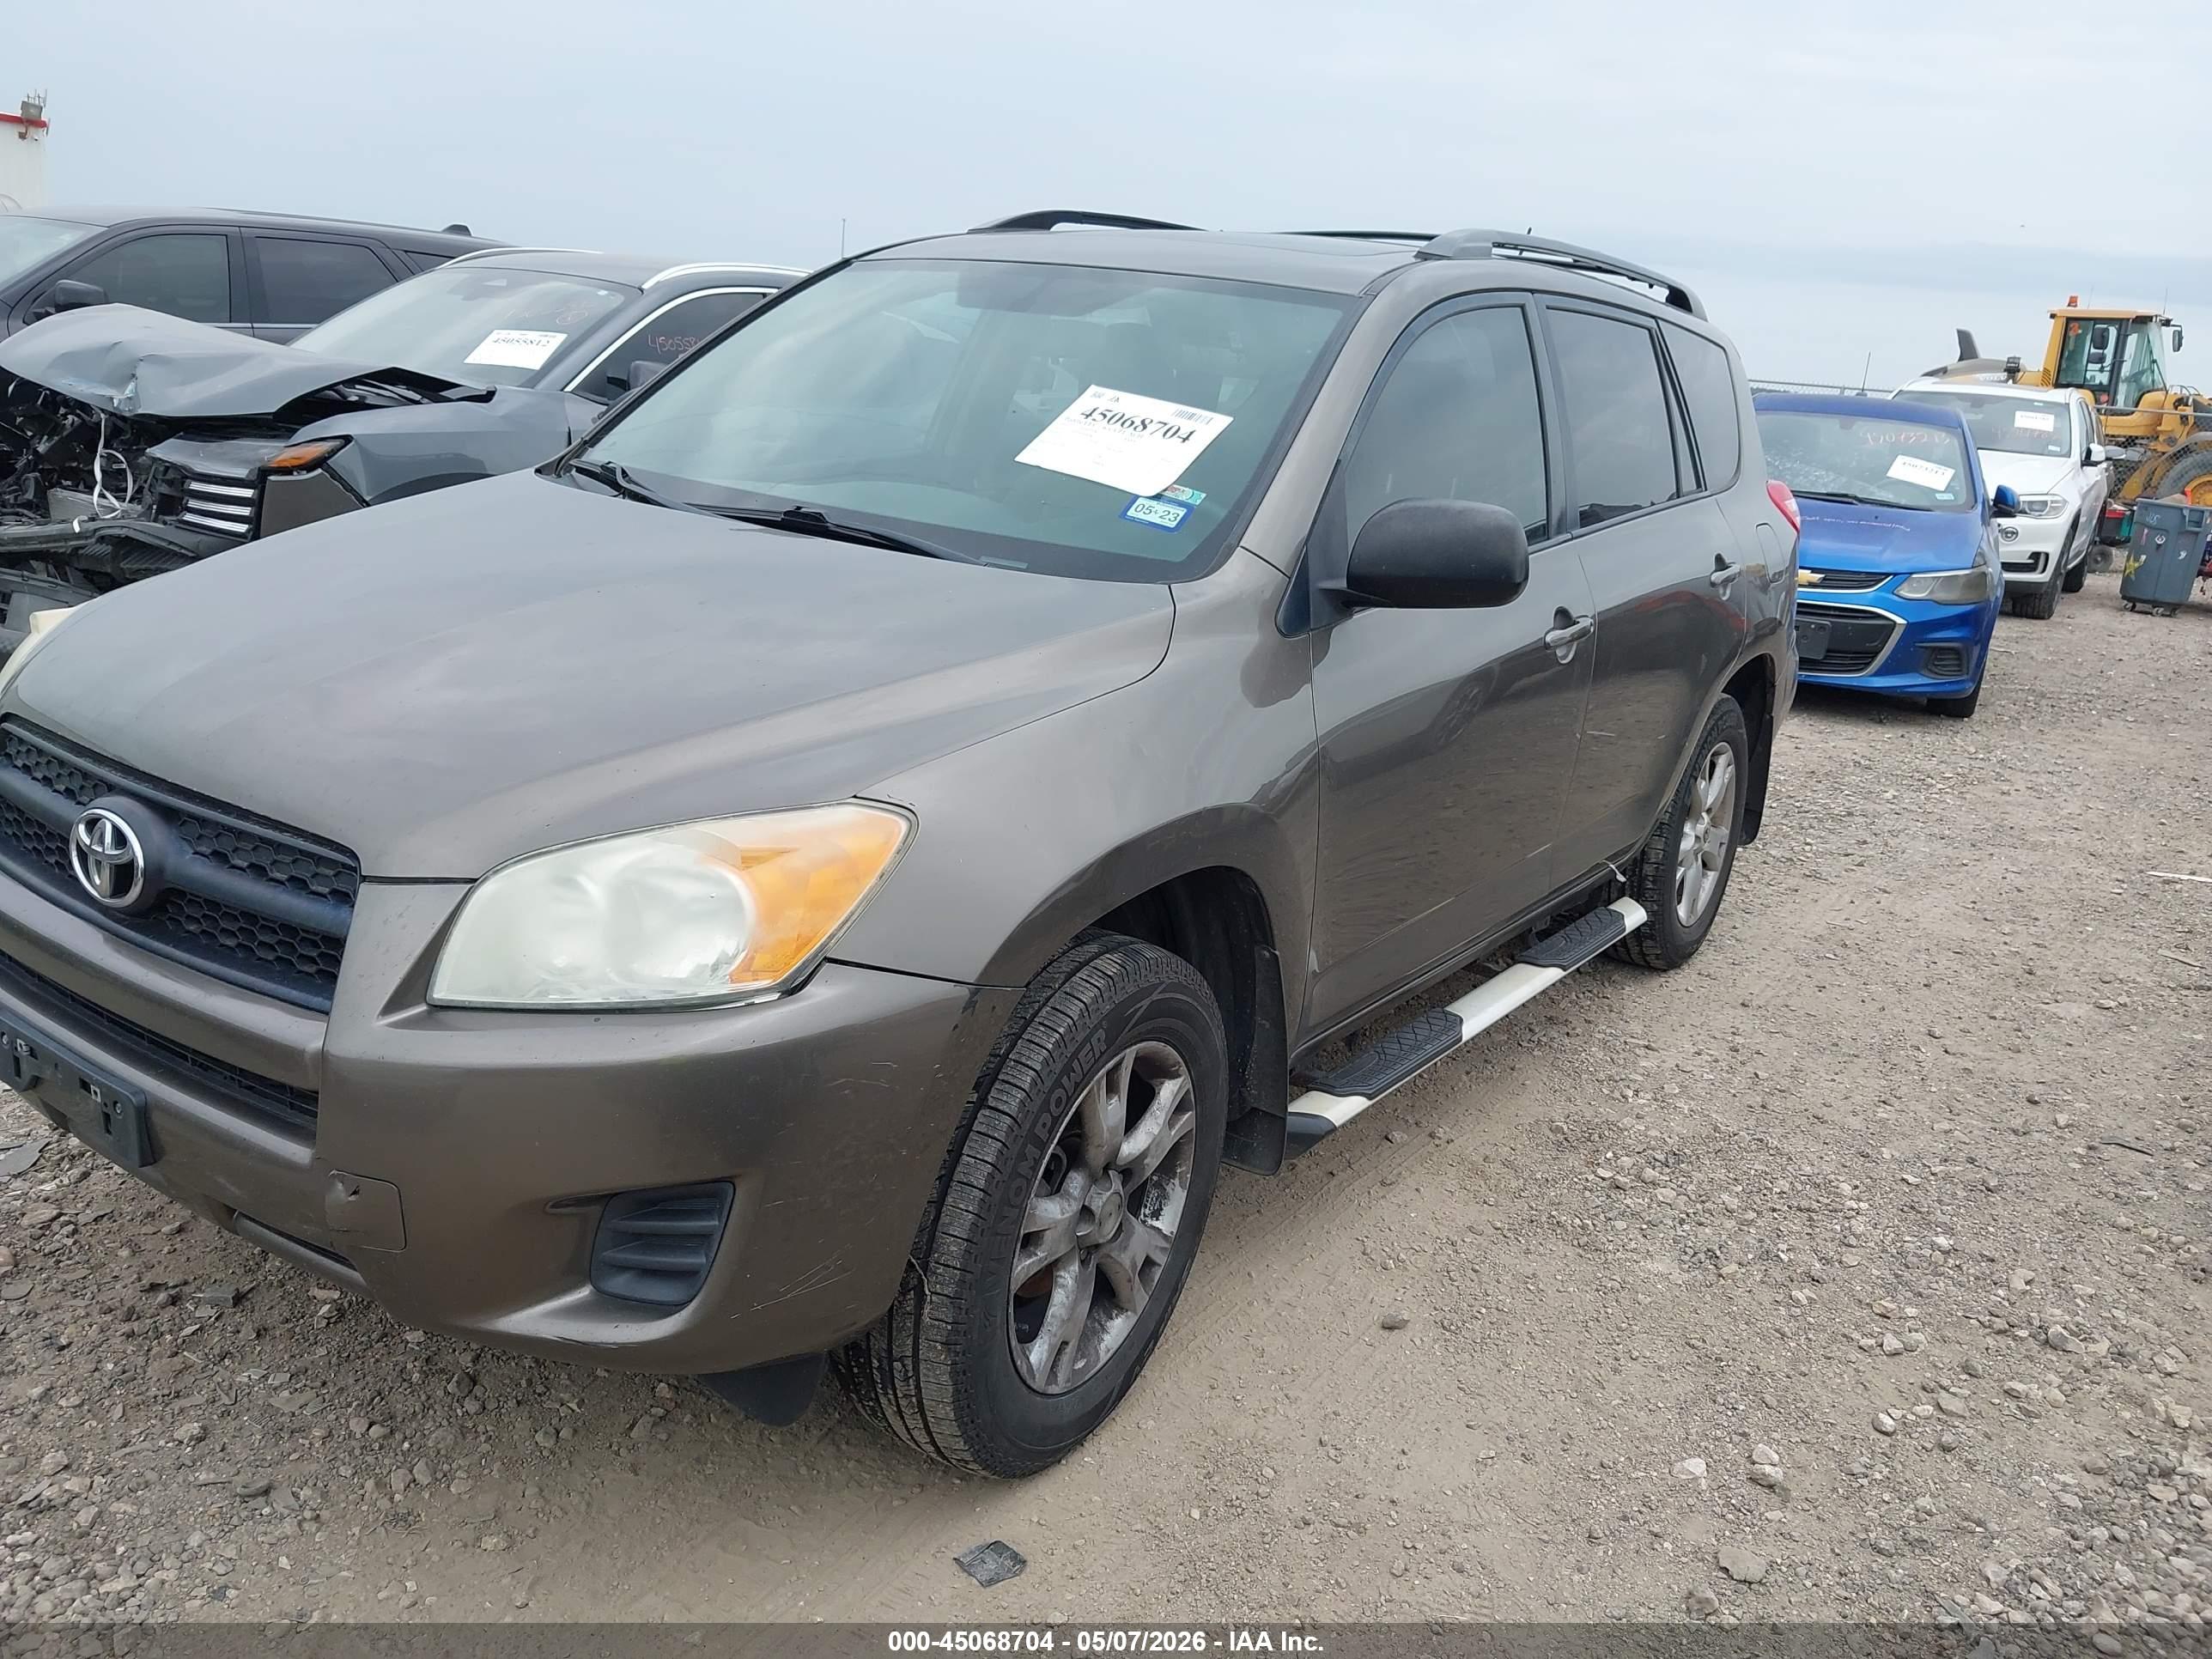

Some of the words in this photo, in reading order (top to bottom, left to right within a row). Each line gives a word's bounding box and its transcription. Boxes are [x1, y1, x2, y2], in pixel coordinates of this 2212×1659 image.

[1079, 405, 1197, 444] 45068704
[1134, 502, 1155, 516] 05
[1158, 509, 1181, 523] 23
[982, 1146, 1042, 1296] VENOM
[1034, 1028, 1108, 1142] POWER
